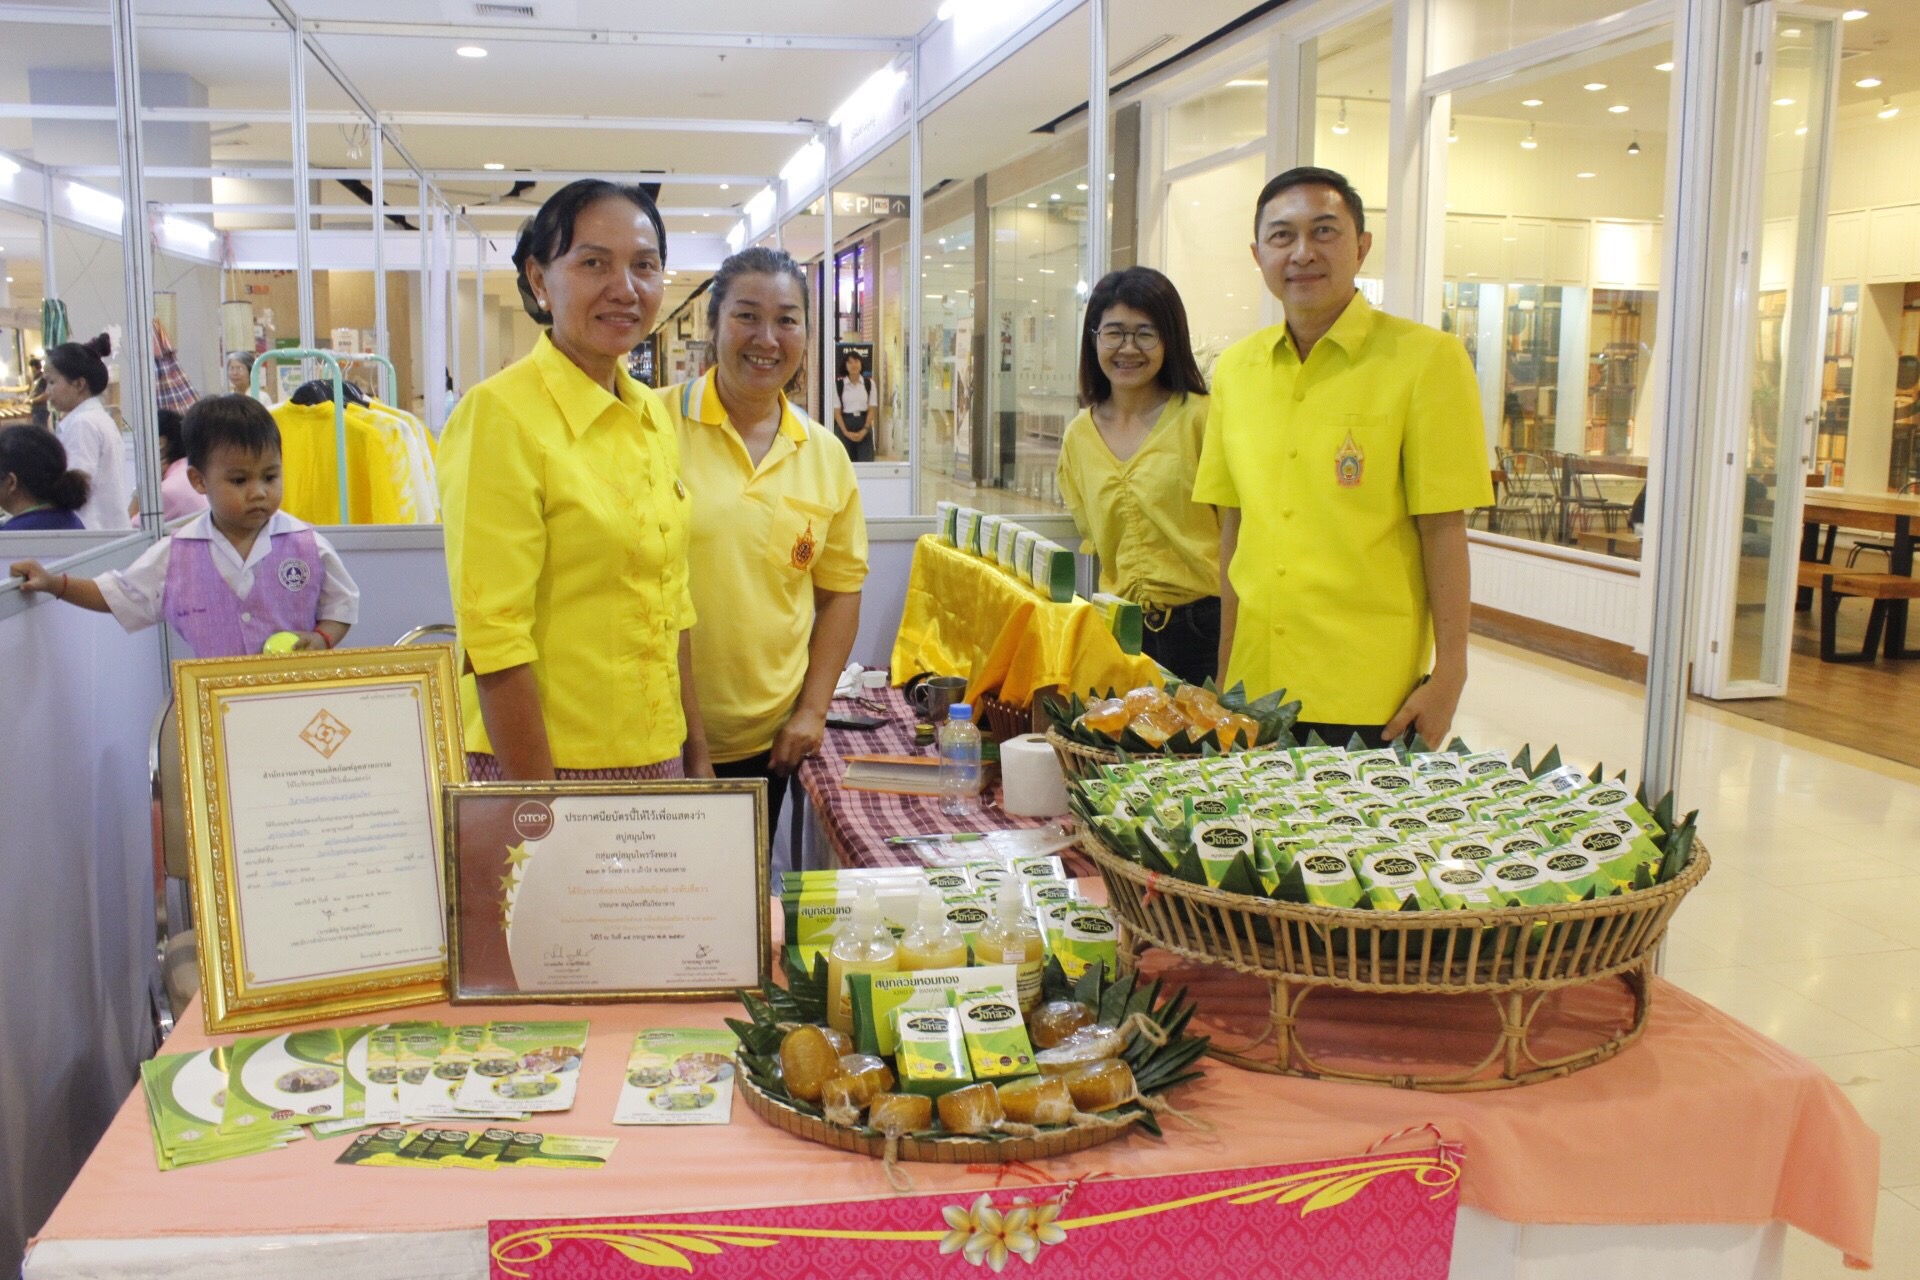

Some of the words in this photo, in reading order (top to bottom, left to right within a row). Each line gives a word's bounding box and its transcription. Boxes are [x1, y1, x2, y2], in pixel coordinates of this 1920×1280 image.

[856, 197, 869, 213] P
[518, 813, 548, 823] OTOP
[564, 808, 706, 822] ประกาศนียบัตรนี้ให้ไว้เพื่อแสดงว่า
[615, 830, 656, 844] สบู่สมุนไพร
[1202, 828, 1248, 848] วังหลวง
[1582, 833, 1622, 851] วังหลวง
[1304, 856, 1347, 874] วังหลวง
[1374, 858, 1417, 875] วังหลวง
[1547, 854, 1589, 871] วังหลวง
[1496, 864, 1540, 880] วังหลวง
[801, 904, 852, 918] สบู่กล้วยหอ
[1071, 916, 1114, 933] วังหลวง
[875, 974, 960, 990] สบู่กล้วยหอมทอง
[967, 1004, 1017, 1022] วังหลวง
[907, 1017, 949, 1033] วังหลว
